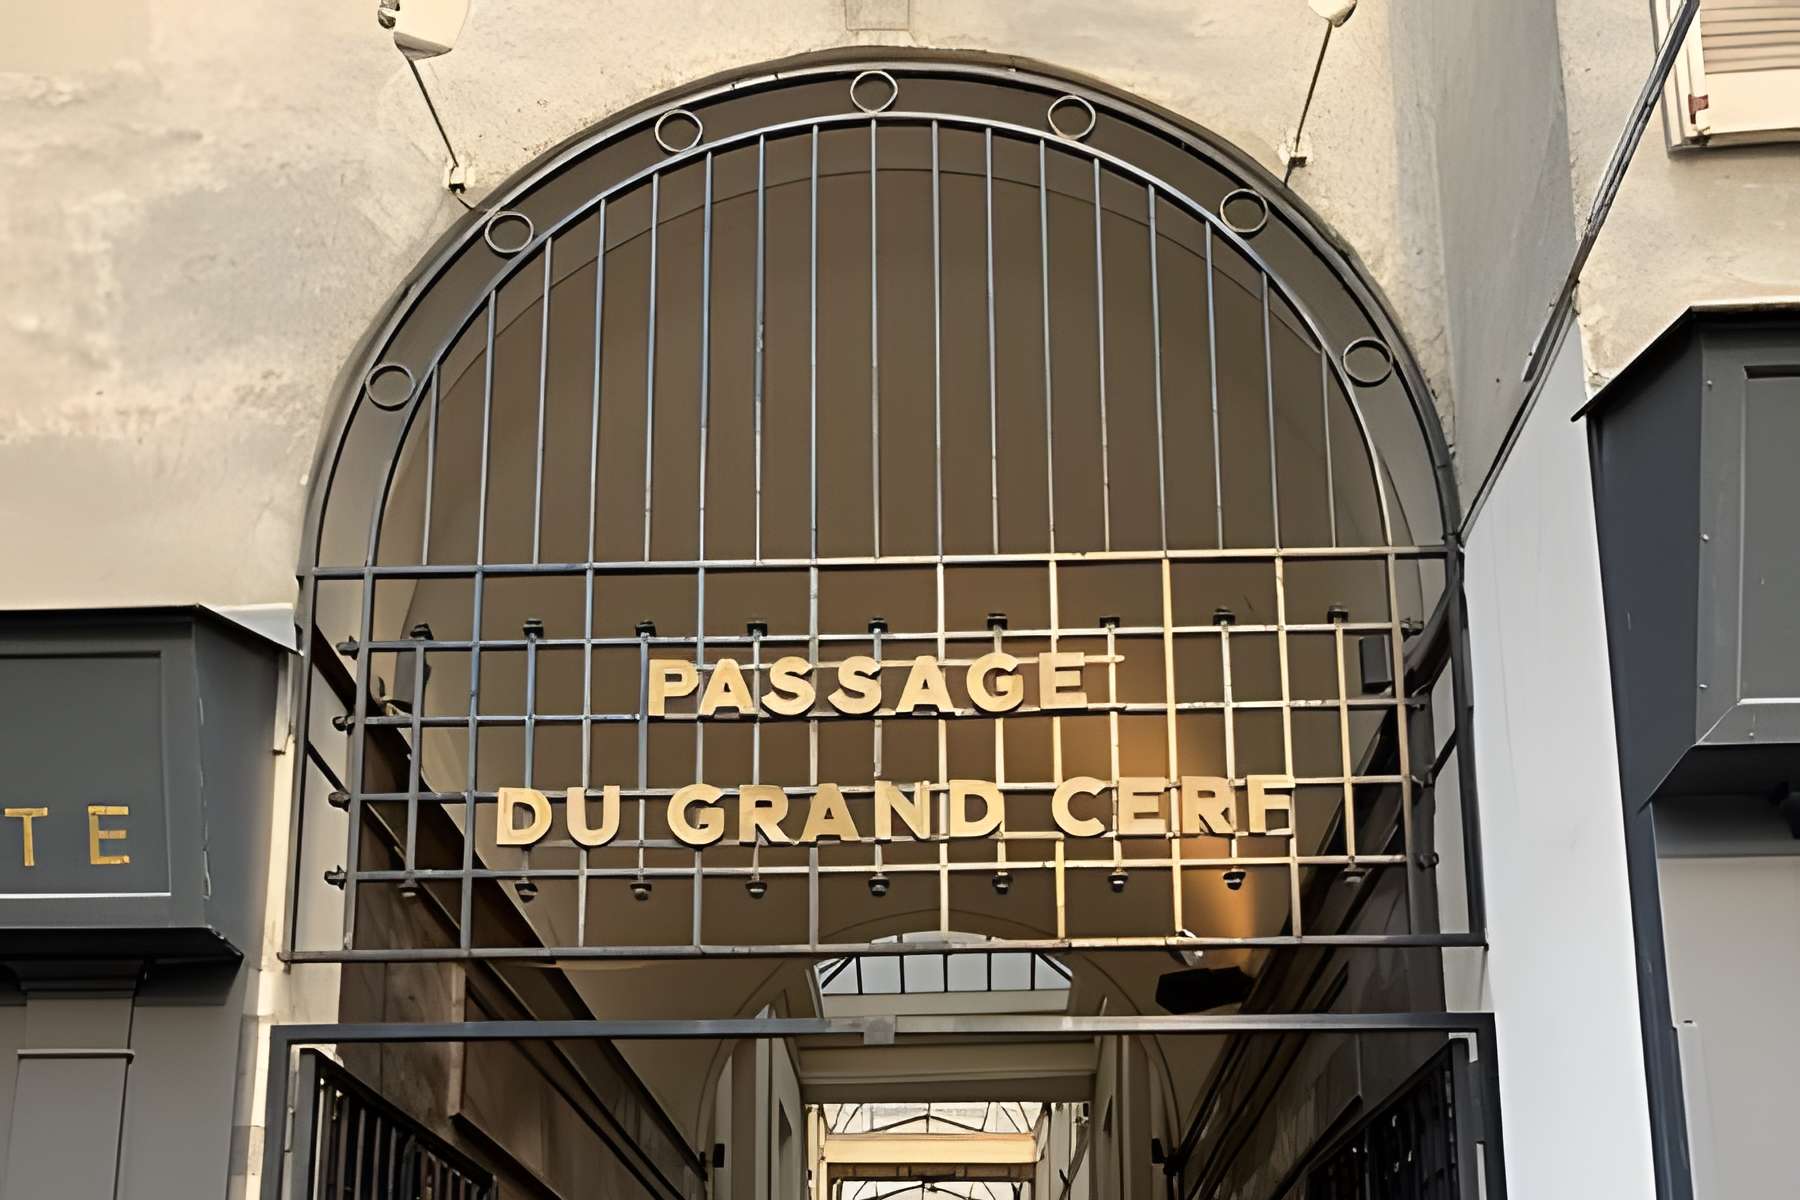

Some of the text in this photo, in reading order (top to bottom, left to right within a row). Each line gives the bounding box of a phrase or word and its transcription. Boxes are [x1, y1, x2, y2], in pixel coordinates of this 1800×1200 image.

[647, 651, 1088, 717] PASSAGE
[3, 804, 131, 867] TE
[496, 774, 1295, 847] DU GRAND CERF
